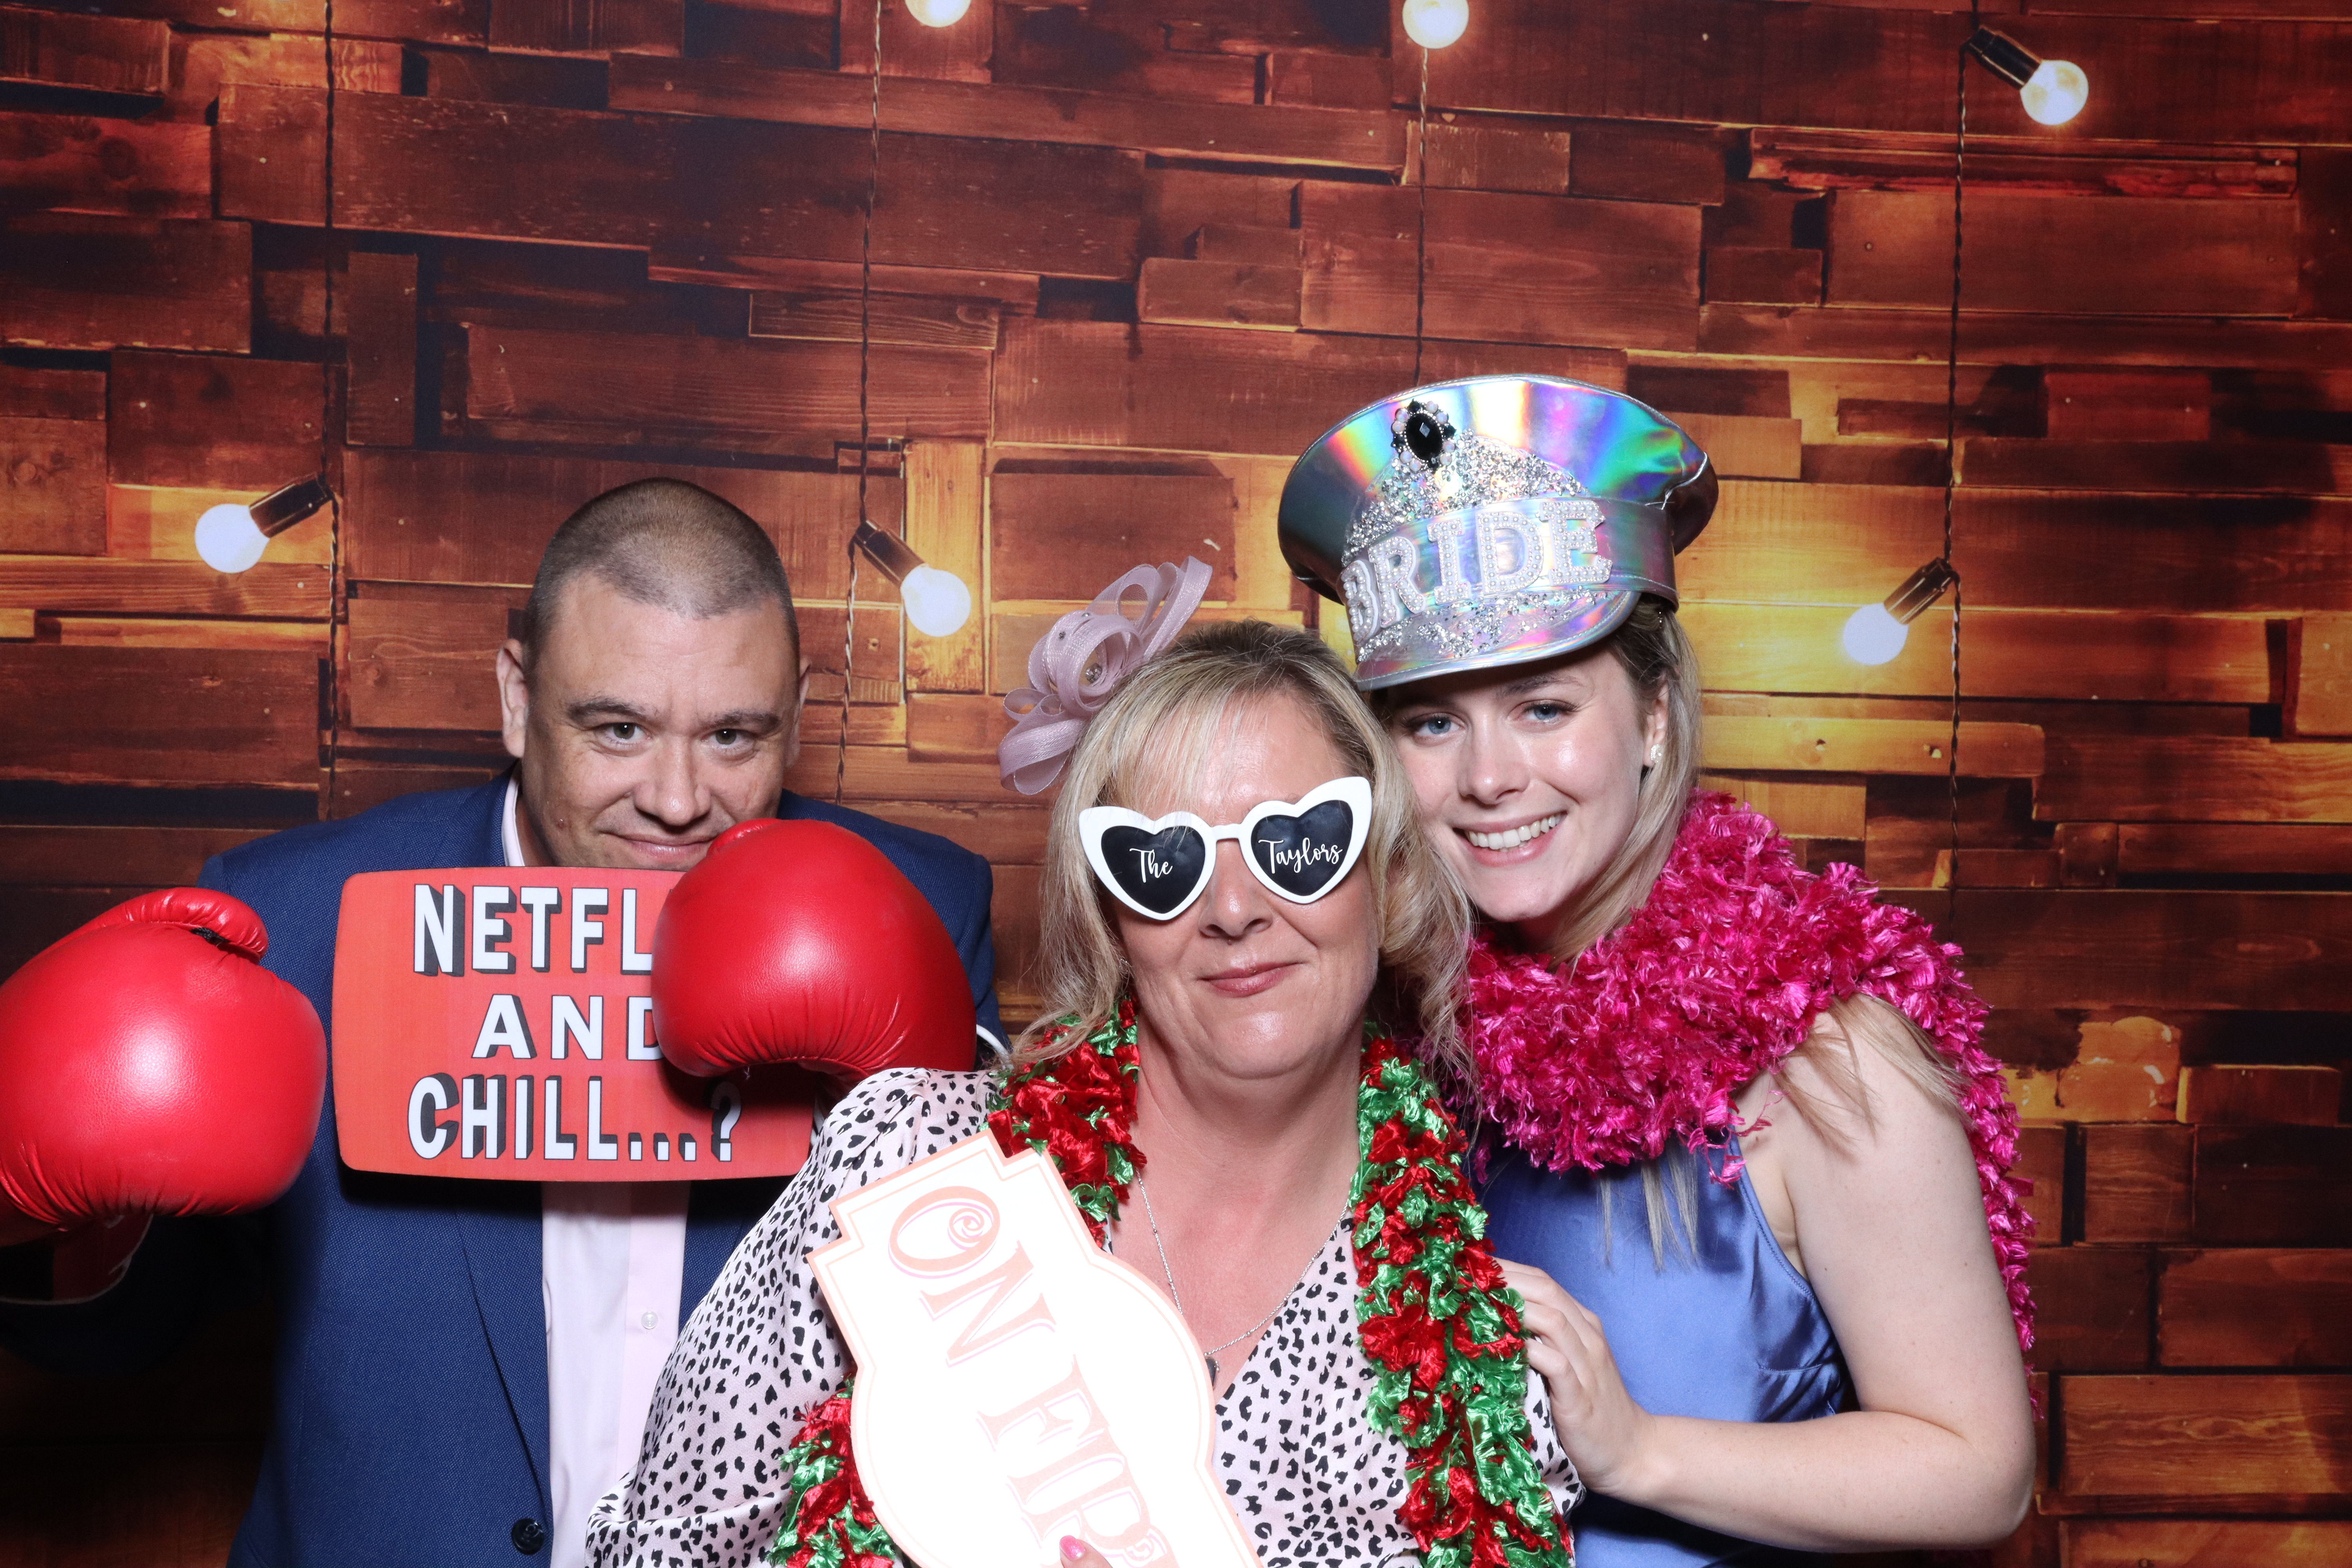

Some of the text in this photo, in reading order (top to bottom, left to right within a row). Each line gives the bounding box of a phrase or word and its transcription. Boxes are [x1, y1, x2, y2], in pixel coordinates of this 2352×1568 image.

[1341, 501, 1613, 643] BRIDE
[1129, 837, 1343, 883] The Taylors
[414, 884, 671, 977] NETFL
[471, 993, 666, 1061] AND
[888, 1185, 1181, 1568] ON FIR
